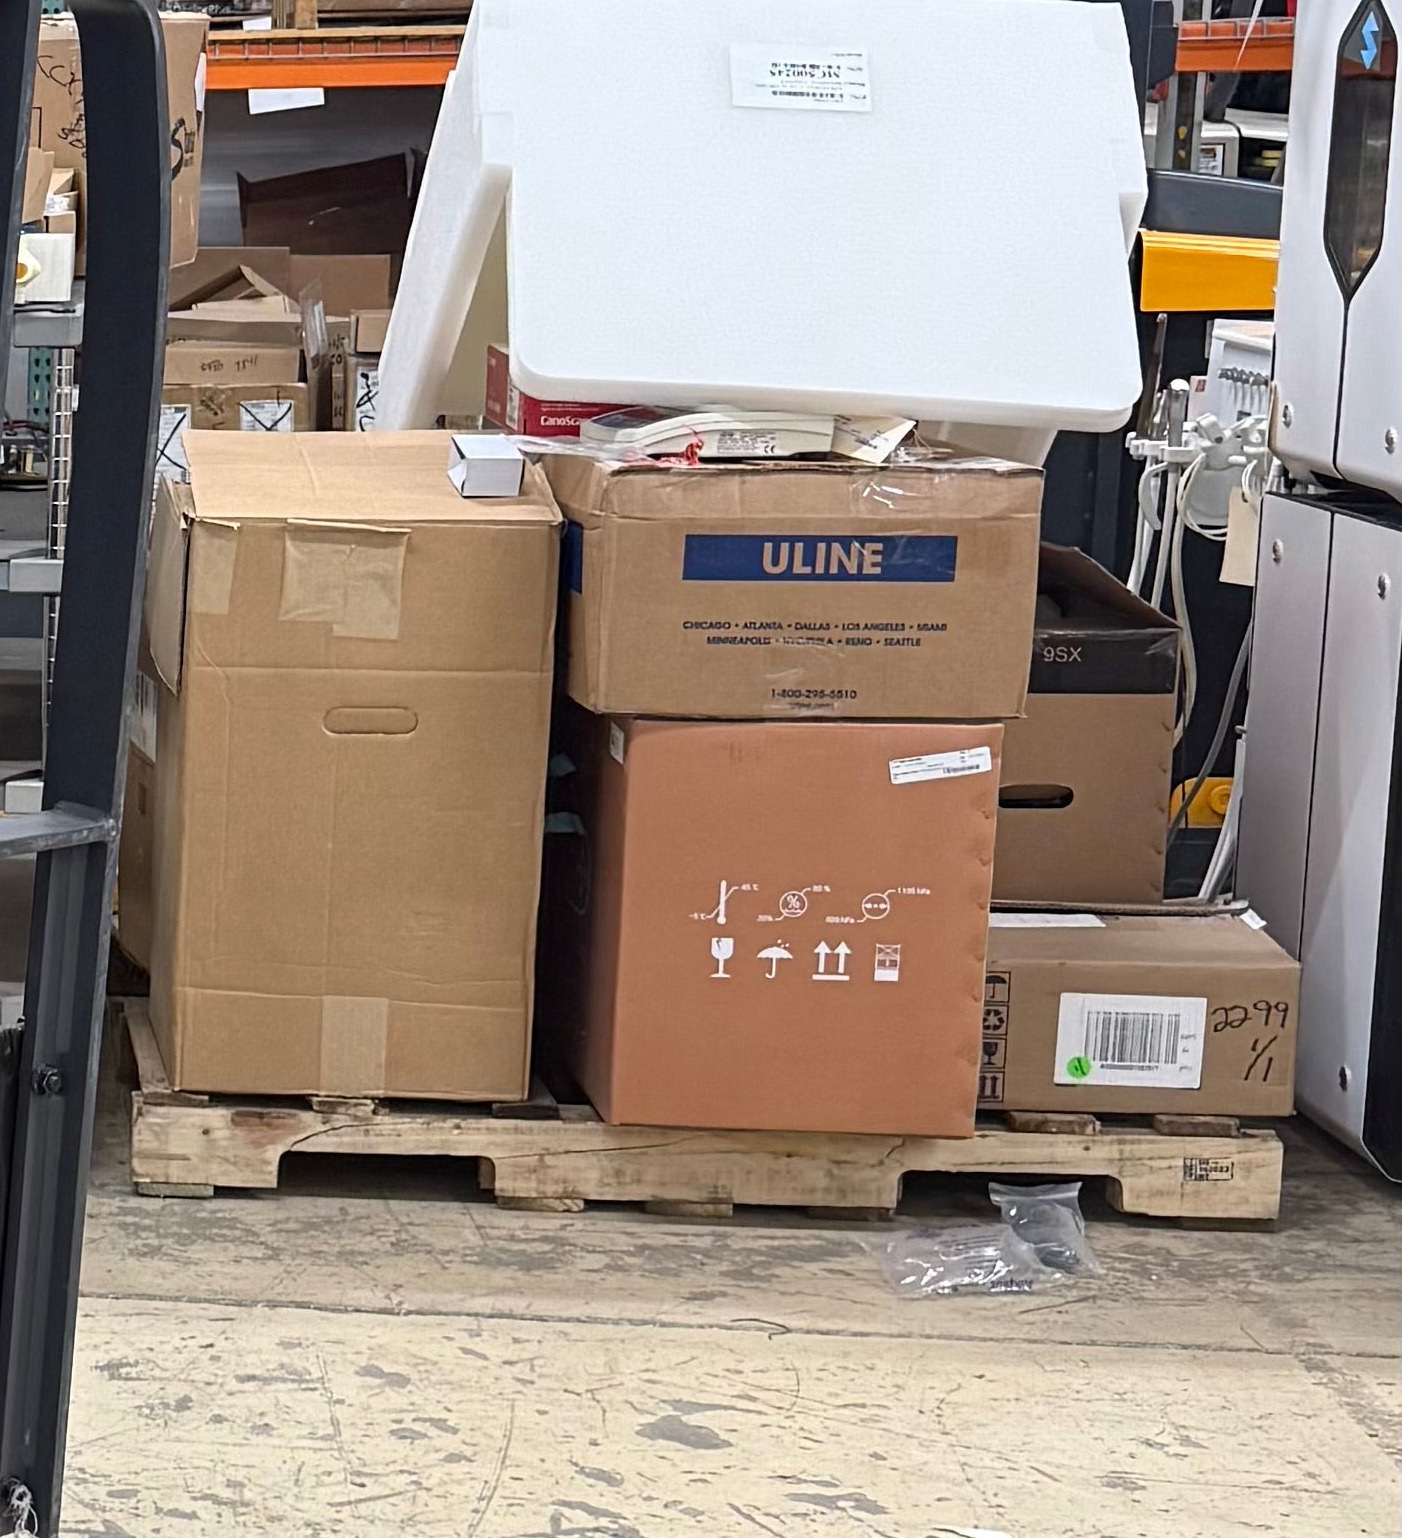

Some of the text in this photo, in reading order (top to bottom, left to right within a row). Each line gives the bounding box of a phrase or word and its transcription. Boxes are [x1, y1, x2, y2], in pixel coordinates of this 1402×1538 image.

[761, 542, 884, 575] ULINE
[683, 621, 731, 630] CHICAGO
[742, 621, 783, 630] ATLANTA
[795, 622, 831, 631] DALLAS
[842, 622, 860, 631] LOS
[862, 622, 905, 631] ANGELES
[884, 637, 921, 646] SEATTLE
[1043, 646, 1082, 662] 9SX
[1211, 999, 1289, 1033] 2299
[1244, 1036, 1278, 1082] 1/1
